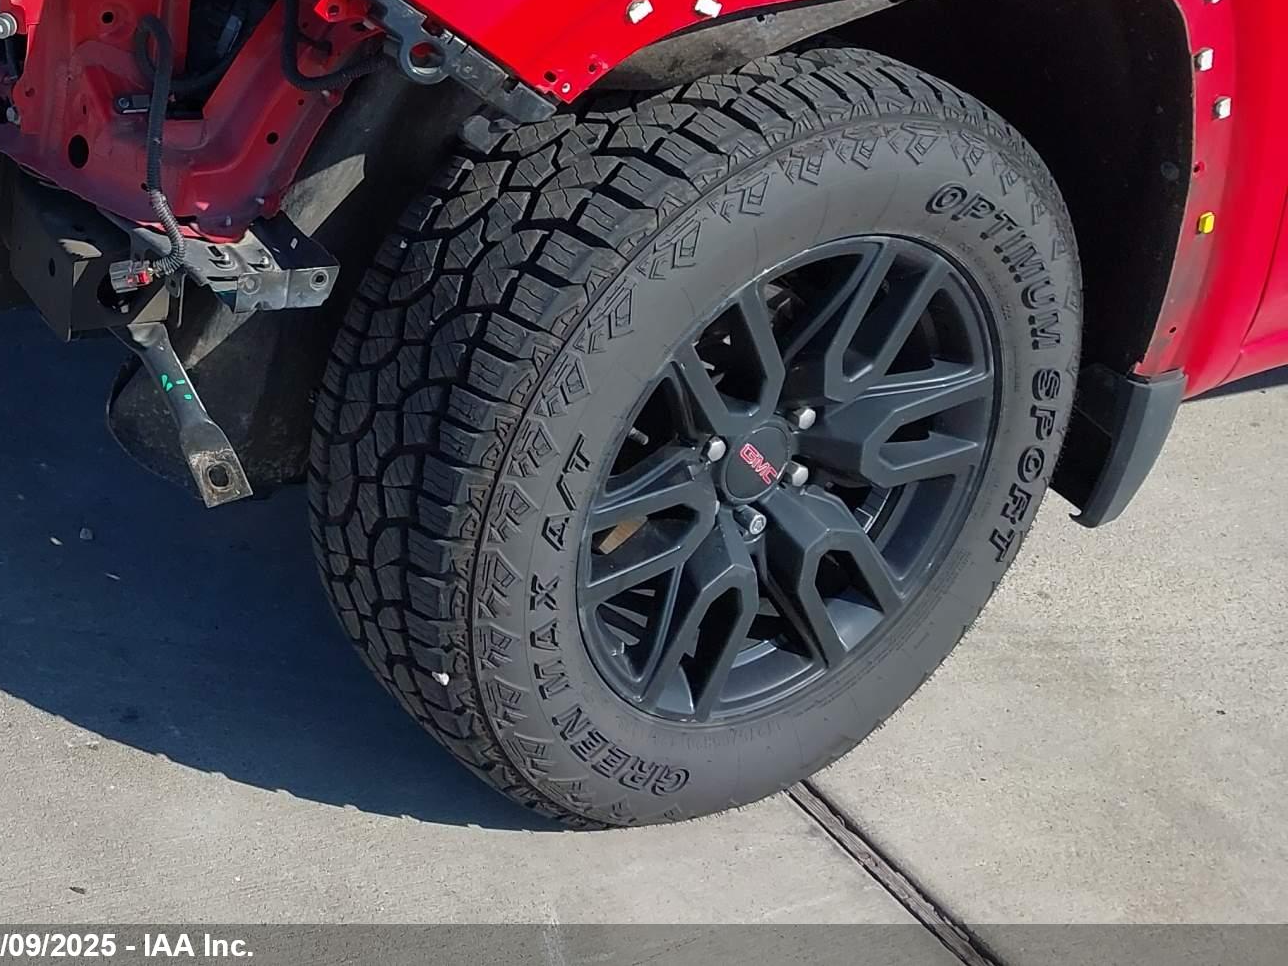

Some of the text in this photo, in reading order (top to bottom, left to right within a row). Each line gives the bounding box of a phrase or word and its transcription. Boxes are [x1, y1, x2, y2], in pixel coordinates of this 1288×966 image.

[925, 182, 1061, 351] OPTIMUM
[740, 443, 777, 485] GMC
[988, 369, 1061, 563] SPORT
[530, 431, 690, 797] GREEN MAX A/T
